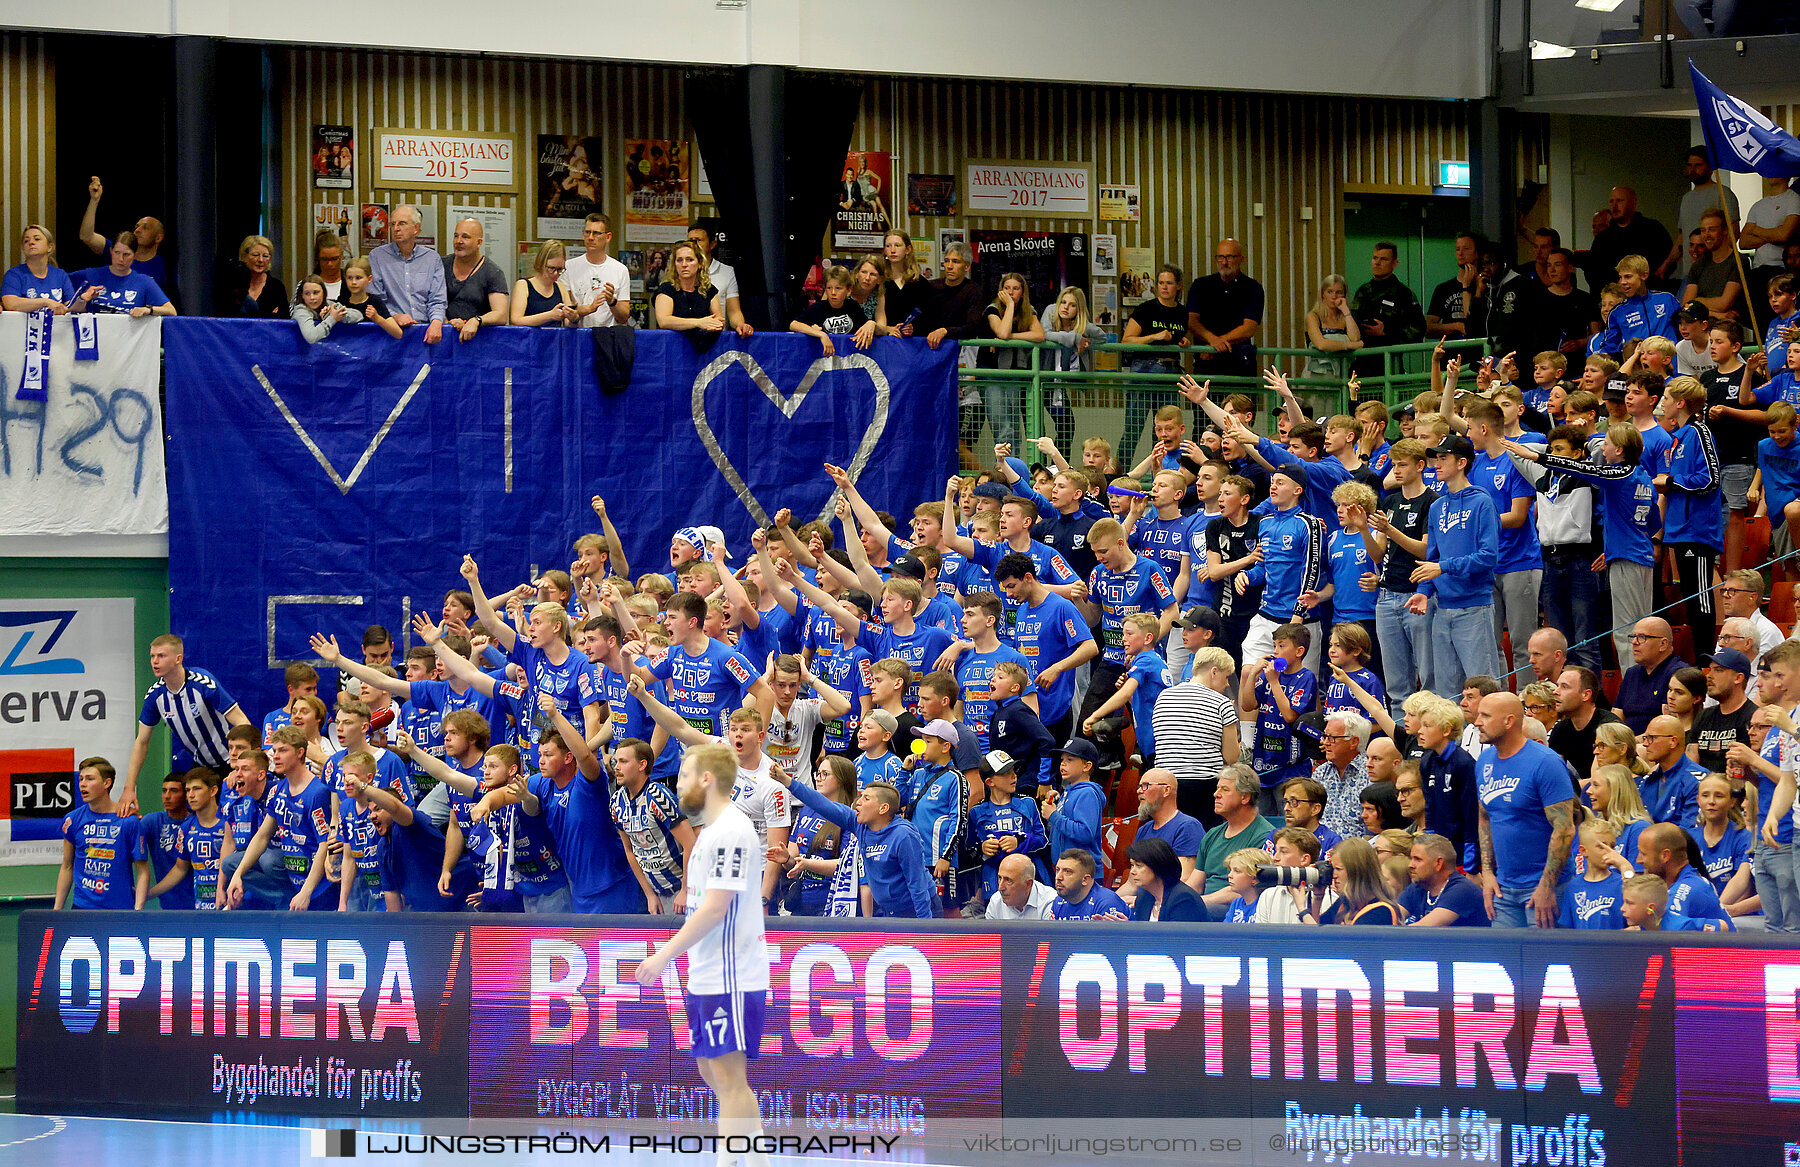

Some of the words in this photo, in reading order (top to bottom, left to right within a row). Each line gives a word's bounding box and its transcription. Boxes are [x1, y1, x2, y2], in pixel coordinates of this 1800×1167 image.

[384, 139, 510, 161] ARRANGEMANG
[425, 160, 469, 180] 2015
[972, 170, 1085, 189] ARRANGEMANG
[1009, 189, 1048, 207] 2017
[836, 211, 885, 222] CHRISTMAS
[848, 221, 874, 230] NIGHT
[977, 240, 1011, 254] Arena
[1013, 236, 1055, 251] Skövde
[1152, 320, 1185, 332] BALAIN
[967, 584, 978, 595] 56
[1151, 572, 1171, 599] MAXI
[815, 621, 830, 636] 41
[1017, 621, 1026, 632] 70
[673, 663, 684, 680] 22
[726, 657, 750, 683] MAXI
[500, 683, 524, 700] MAXI
[678, 704, 709, 715] VOLVO
[13, 781, 73, 810] PLS
[1478, 775, 1521, 801] Salming
[275, 798, 285, 815] 22
[774, 790, 785, 818] MAXI
[312, 807, 329, 836] MAXI
[615, 806, 629, 823] 24
[83, 824, 96, 835] 39
[84, 859, 111, 872] RAPP
[1576, 896, 1615, 919] Salming
[58, 934, 422, 1044] OPTIMERA
[705, 1018, 728, 1048] 17
[1058, 952, 1603, 1095] OPTIMERA
[211, 1053, 321, 1106] Bygghandel
[326, 1057, 356, 1100] för
[360, 1058, 423, 1111] proffs
[536, 1071, 642, 1121] BYGGPLÅT
[804, 1089, 926, 1137] ISOLERING
[1285, 1100, 1449, 1165] Bygghandel
[1458, 1106, 1502, 1162] för
[1510, 1112, 1607, 1167] proffs
